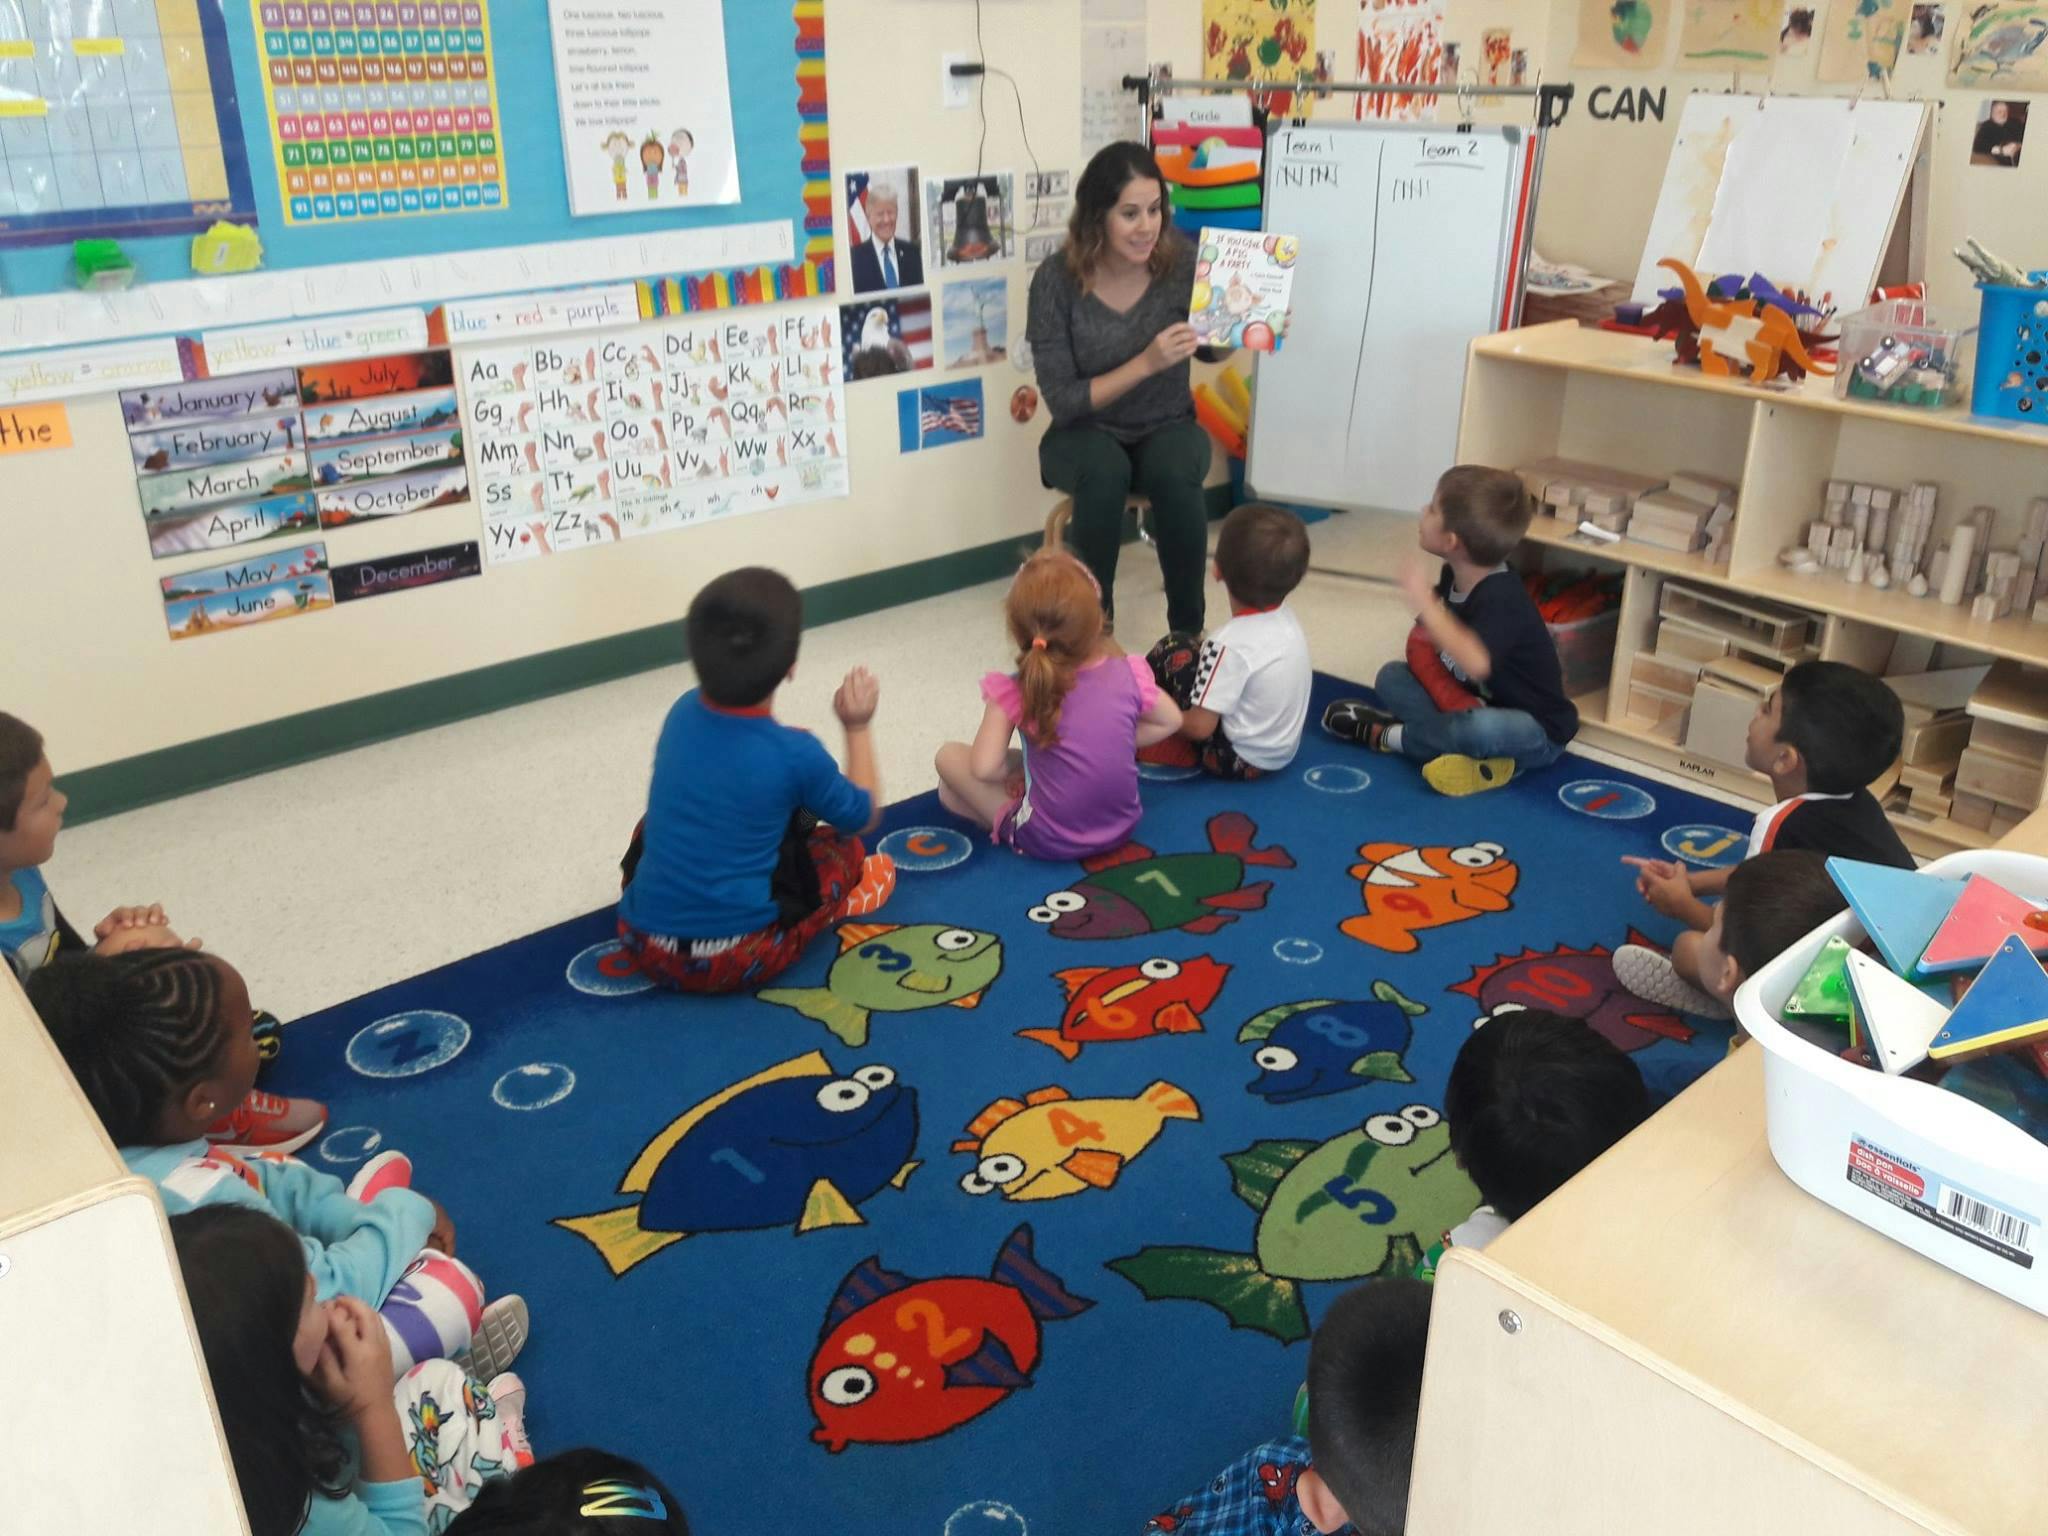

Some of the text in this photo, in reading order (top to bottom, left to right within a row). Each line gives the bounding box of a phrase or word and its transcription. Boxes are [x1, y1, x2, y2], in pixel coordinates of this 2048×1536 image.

[1190, 109, 1220, 122] Circle
[1587, 85, 1667, 122] CAN
[1282, 131, 1322, 154] Team
[1418, 137, 1479, 159] Team 2
[450, 309, 488, 333] blue
[514, 303, 544, 326] red
[566, 295, 620, 327] purple
[212, 336, 276, 369] yellow
[302, 328, 341, 350] blue
[356, 327, 409, 352] green
[471, 360, 498, 382] Aa
[535, 350, 562, 372] Bb
[602, 342, 626, 362] Cc
[666, 330, 692, 355] Dd
[726, 325, 749, 347] Ee
[360, 362, 399, 388] July
[170, 391, 256, 414] January
[474, 400, 502, 426] Gg
[539, 388, 570, 412] Hh
[669, 372, 689, 398] Jj
[728, 361, 751, 385] Kk
[0, 414, 52, 445] the
[348, 405, 418, 430] August
[481, 393, 809, 464] Mm Nn Oo Pp Qq Rr
[172, 430, 272, 455] February
[338, 440, 442, 475] September
[486, 429, 816, 503] Ss Tt Uu Vv Ww Xx
[187, 468, 260, 499] March
[354, 483, 439, 511] October
[208, 507, 265, 542] April
[489, 511, 581, 548] Yy Zz
[622, 509, 634, 522] th
[225, 565, 273, 588] May
[360, 554, 457, 587] December
[226, 595, 276, 617] June
[1679, 759, 1715, 777] KAPLAN
[1134, 869, 1181, 897] 7
[1380, 891, 1434, 920] 9
[859, 943, 913, 974] 3
[1505, 964, 1594, 1008] 10
[1087, 996, 1138, 1032] 6
[1304, 1013, 1371, 1049] 8
[1047, 1107, 1108, 1148] 4
[709, 1147, 767, 1184] 1
[1856, 1147, 1894, 1171] dish pan
[1868, 1143, 1918, 1172] essentials
[1855, 1157, 1872, 1172] bac
[1883, 1173, 1920, 1196] vaisselle
[1323, 1173, 1398, 1226] 5
[895, 1297, 972, 1358] 2
